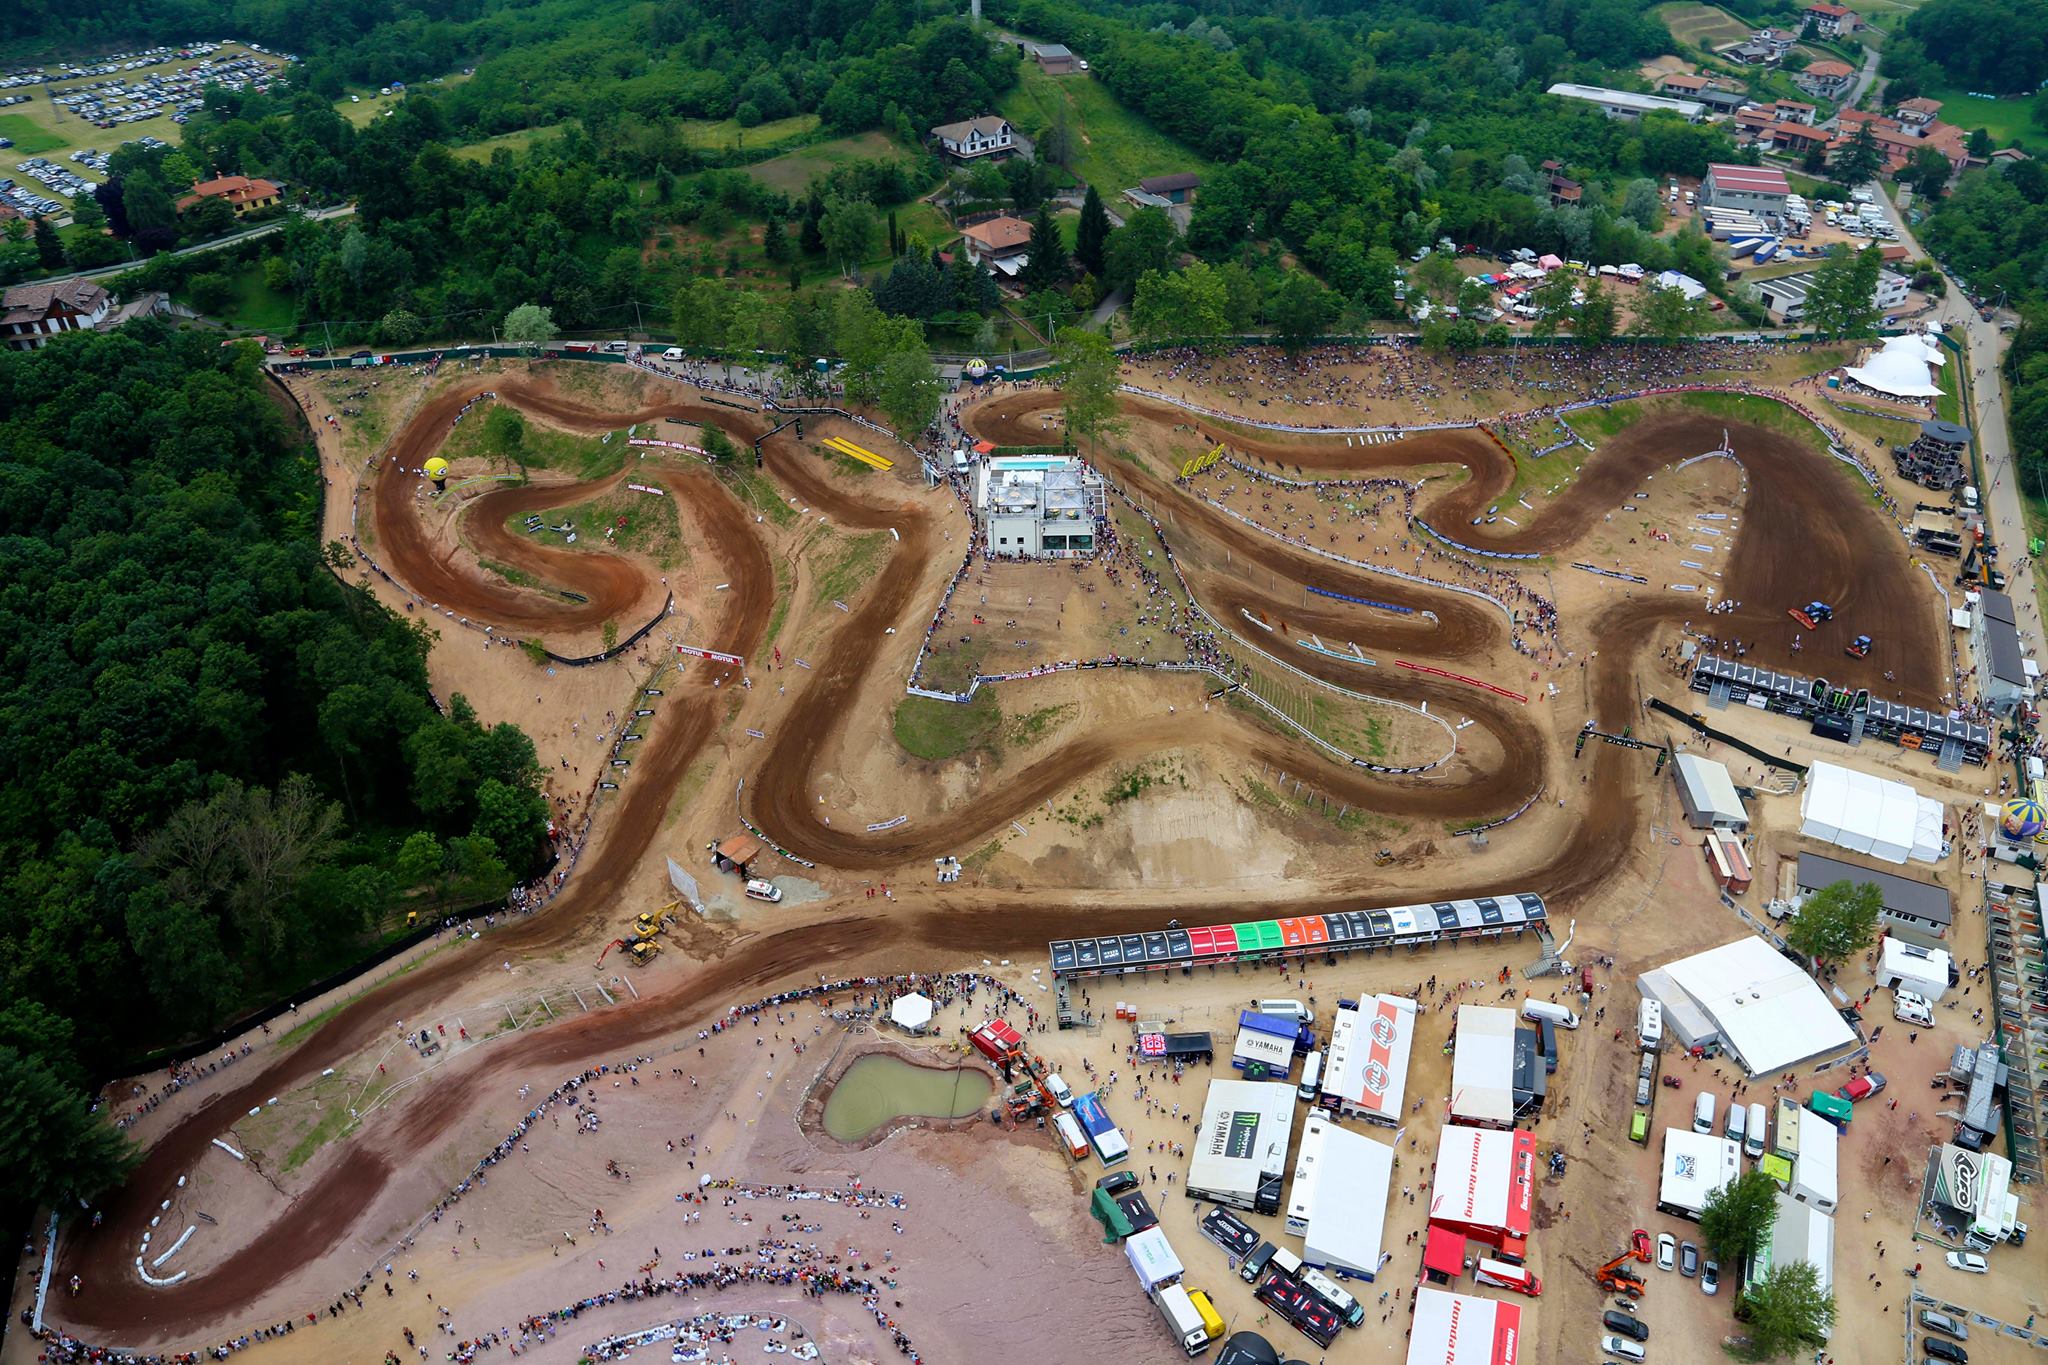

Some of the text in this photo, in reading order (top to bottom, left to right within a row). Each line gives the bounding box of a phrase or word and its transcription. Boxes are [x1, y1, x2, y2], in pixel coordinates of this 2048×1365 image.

[681, 648, 735, 664] MOTUL MOTUL
[1255, 1040, 1283, 1053] YAMAHA
[1377, 1016, 1390, 1047] NILS
[1369, 1061, 1383, 1094] NILS
[1211, 1120, 1229, 1156] YAMAHA
[1464, 1132, 1482, 1218] Honda Racing
[1520, 1152, 1533, 1211] Honda Racing
[1956, 1164, 1972, 1208] UFO
[1448, 1300, 1462, 1349] Honda
[1504, 1327, 1516, 1362] Honda
